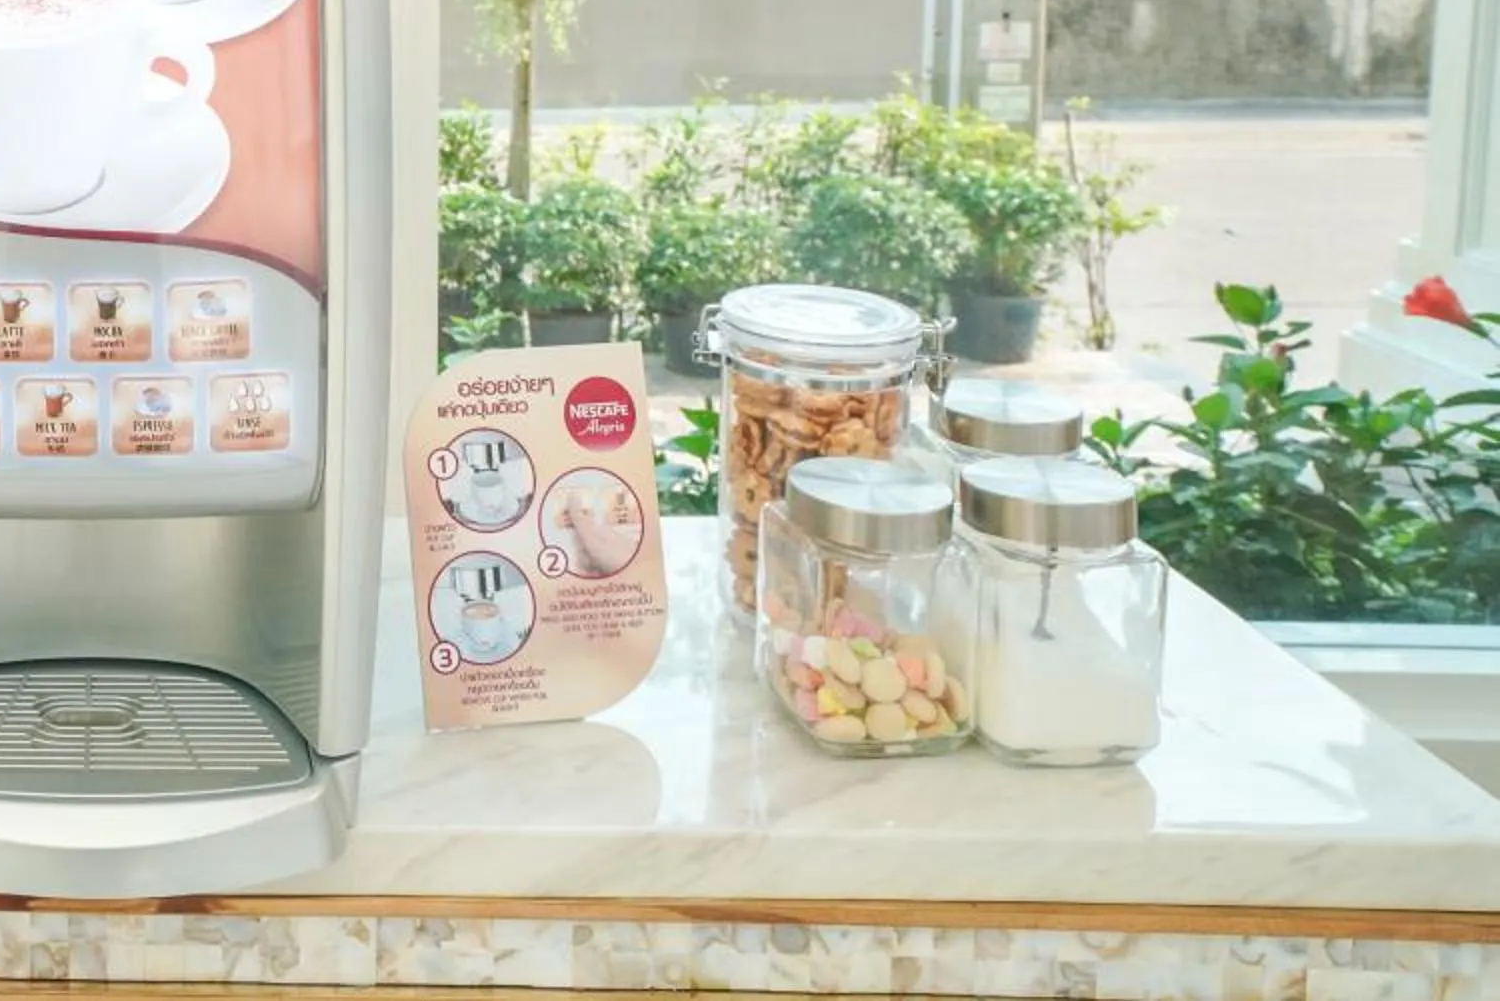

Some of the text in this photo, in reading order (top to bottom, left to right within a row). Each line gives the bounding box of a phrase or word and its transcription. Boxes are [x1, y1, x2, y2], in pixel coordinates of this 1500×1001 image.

[435, 456, 447, 474] 1
[544, 553, 560, 572] 2
[439, 647, 453, 668] 3
